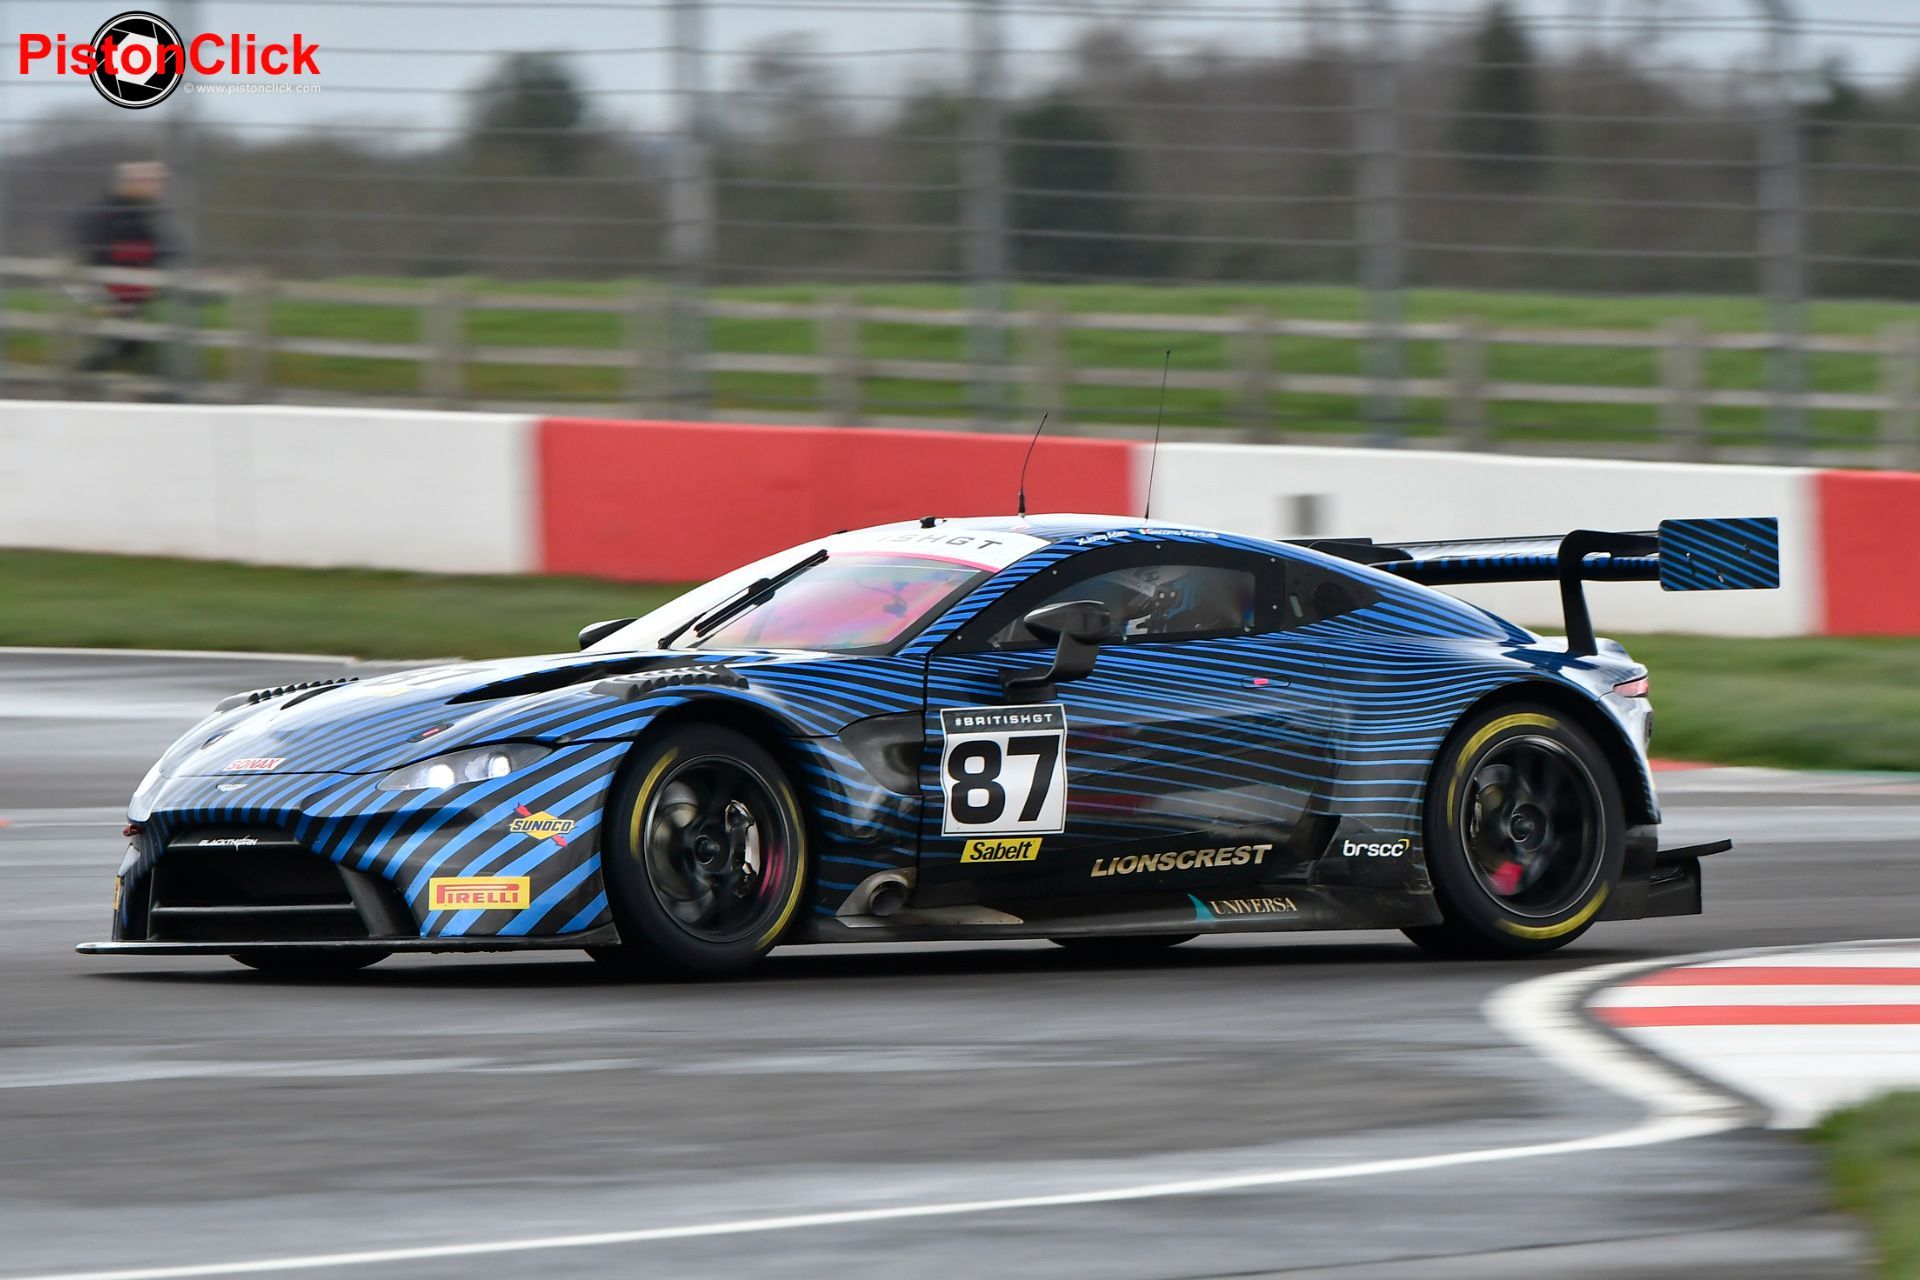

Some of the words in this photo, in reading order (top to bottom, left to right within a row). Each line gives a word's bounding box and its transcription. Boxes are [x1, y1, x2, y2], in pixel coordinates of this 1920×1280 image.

[955, 713, 1053, 726] #BRITISHGT
[226, 759, 280, 770] SONAX
[948, 735, 1061, 824] 87
[512, 820, 572, 832] SUNOCO
[970, 840, 1032, 861] Sabelt
[1343, 839, 1405, 858] brscc
[1090, 844, 1273, 877] LIONSCREST
[436, 884, 520, 904] PIRELLI
[1211, 897, 1299, 916] UNIVERSA
